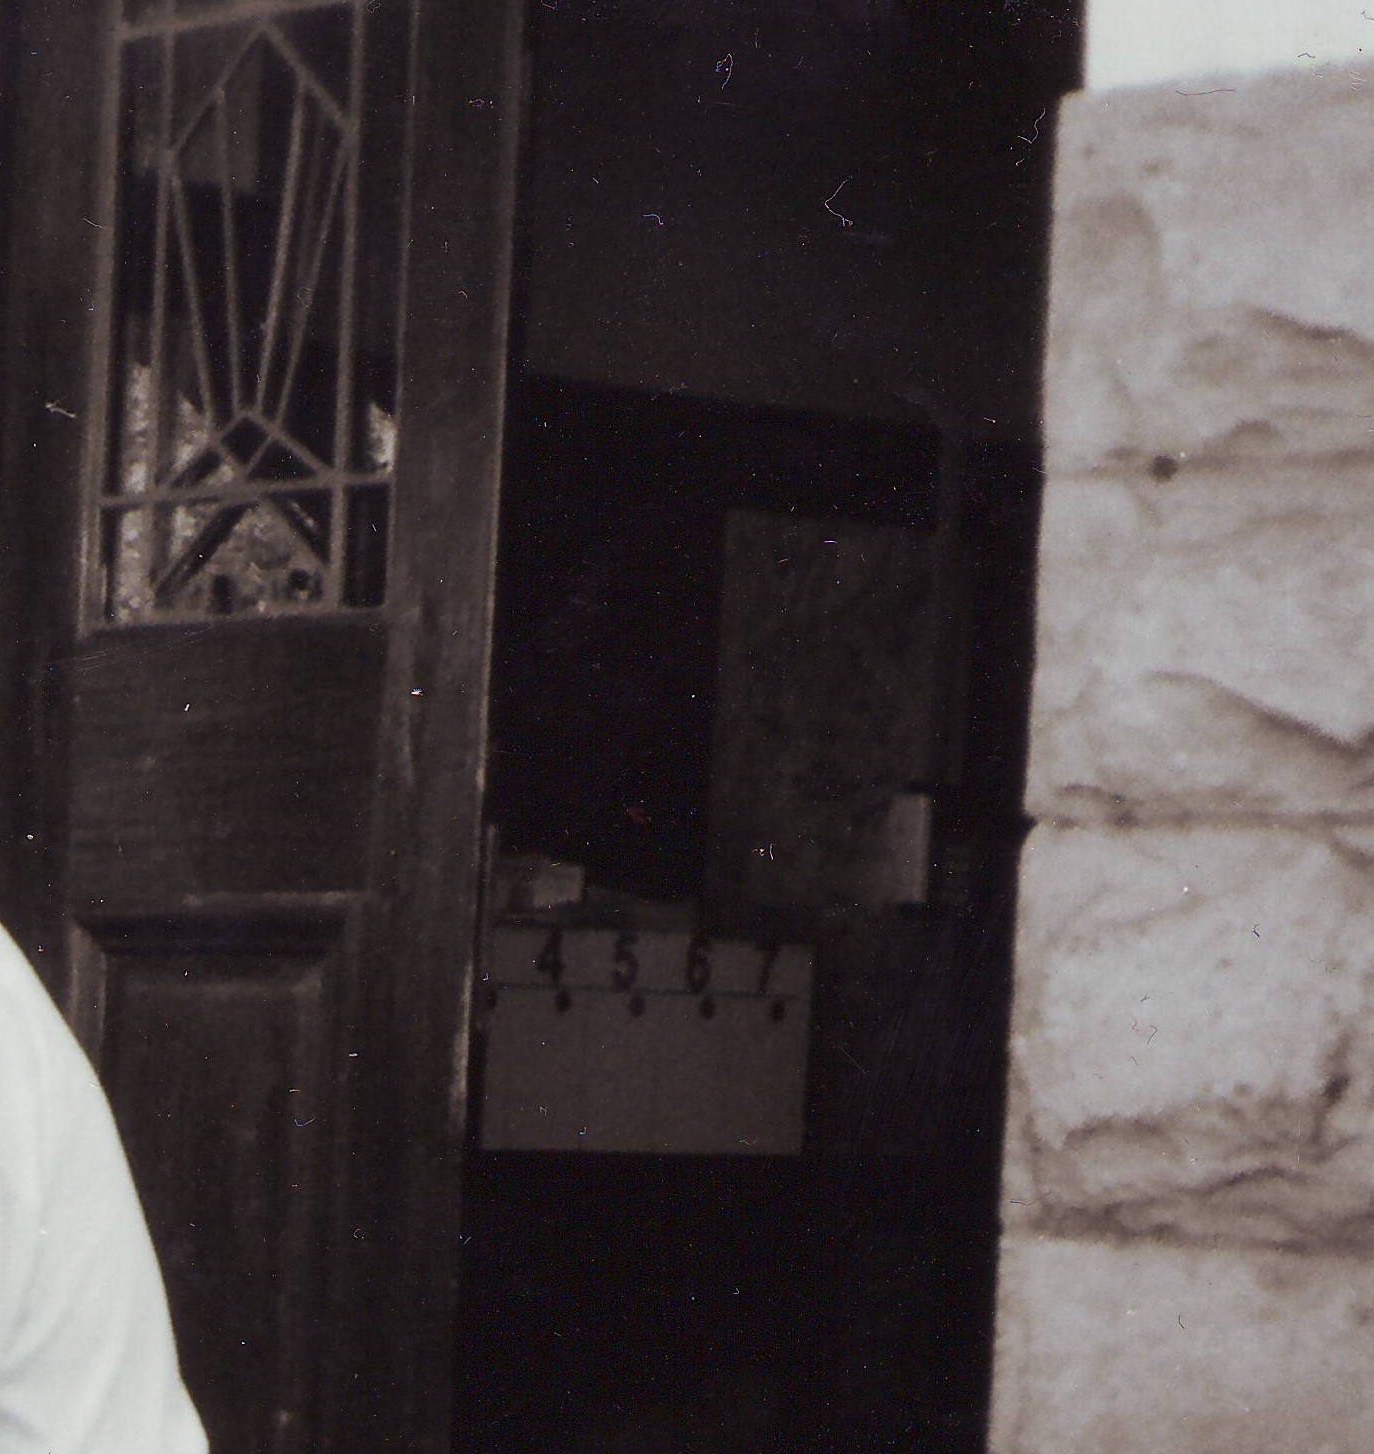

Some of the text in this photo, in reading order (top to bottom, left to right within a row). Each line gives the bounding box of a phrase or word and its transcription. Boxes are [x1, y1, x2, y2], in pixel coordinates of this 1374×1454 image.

[537, 927, 564, 985] 4
[612, 931, 639, 989] 5
[687, 932, 712, 994] 6
